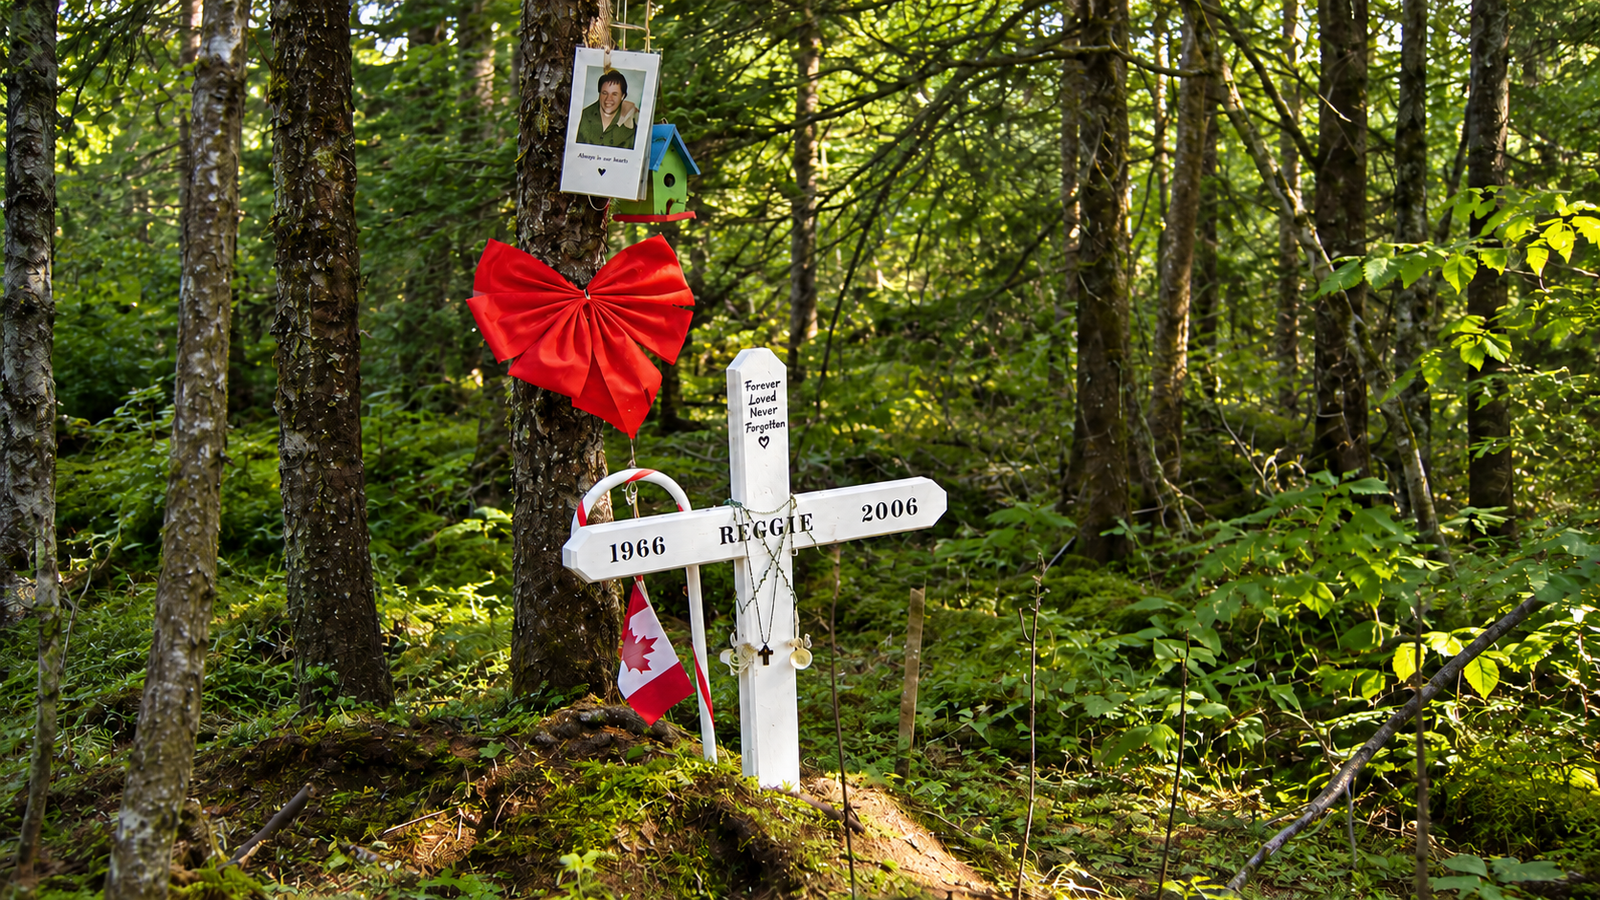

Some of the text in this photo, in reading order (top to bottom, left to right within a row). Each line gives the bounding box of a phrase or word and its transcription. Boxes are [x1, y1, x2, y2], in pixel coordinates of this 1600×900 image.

[577, 152, 596, 161] Always
[613, 156, 629, 164] hearts
[744, 379, 781, 392] Forever
[748, 390, 777, 406] Loved
[750, 406, 778, 419] Never
[744, 419, 786, 434] Forgotten
[609, 496, 919, 564] 1966 REGGIE 2006
